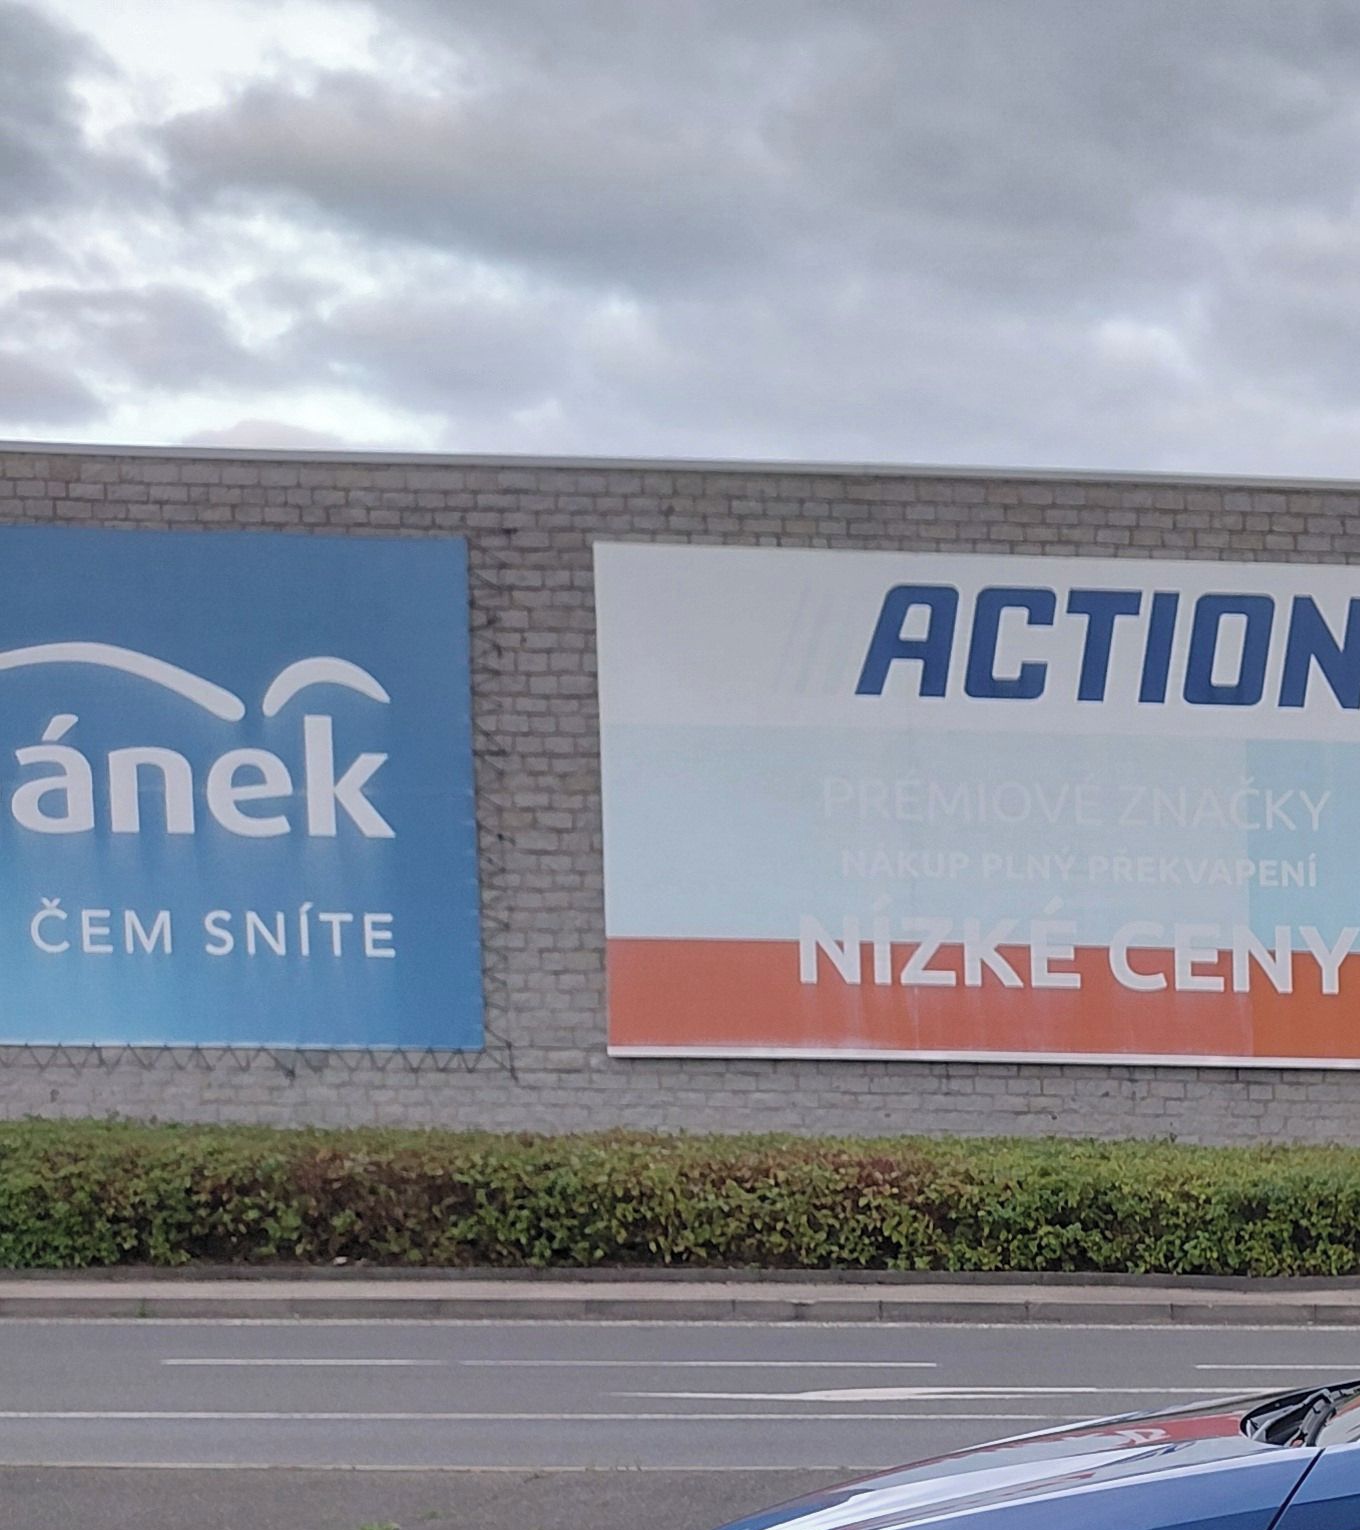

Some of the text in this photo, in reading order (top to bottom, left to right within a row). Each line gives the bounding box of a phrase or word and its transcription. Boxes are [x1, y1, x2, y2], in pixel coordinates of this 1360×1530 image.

[821, 767, 1333, 833] PRÉMIOVÉ ZNAČKY
[839, 840, 1318, 889] NÁKUP PLNÝ PŘEKVAPENÍ
[30, 898, 397, 958] ČEM SNÍTE
[799, 896, 1360, 996] NÍZKÉ CENY
